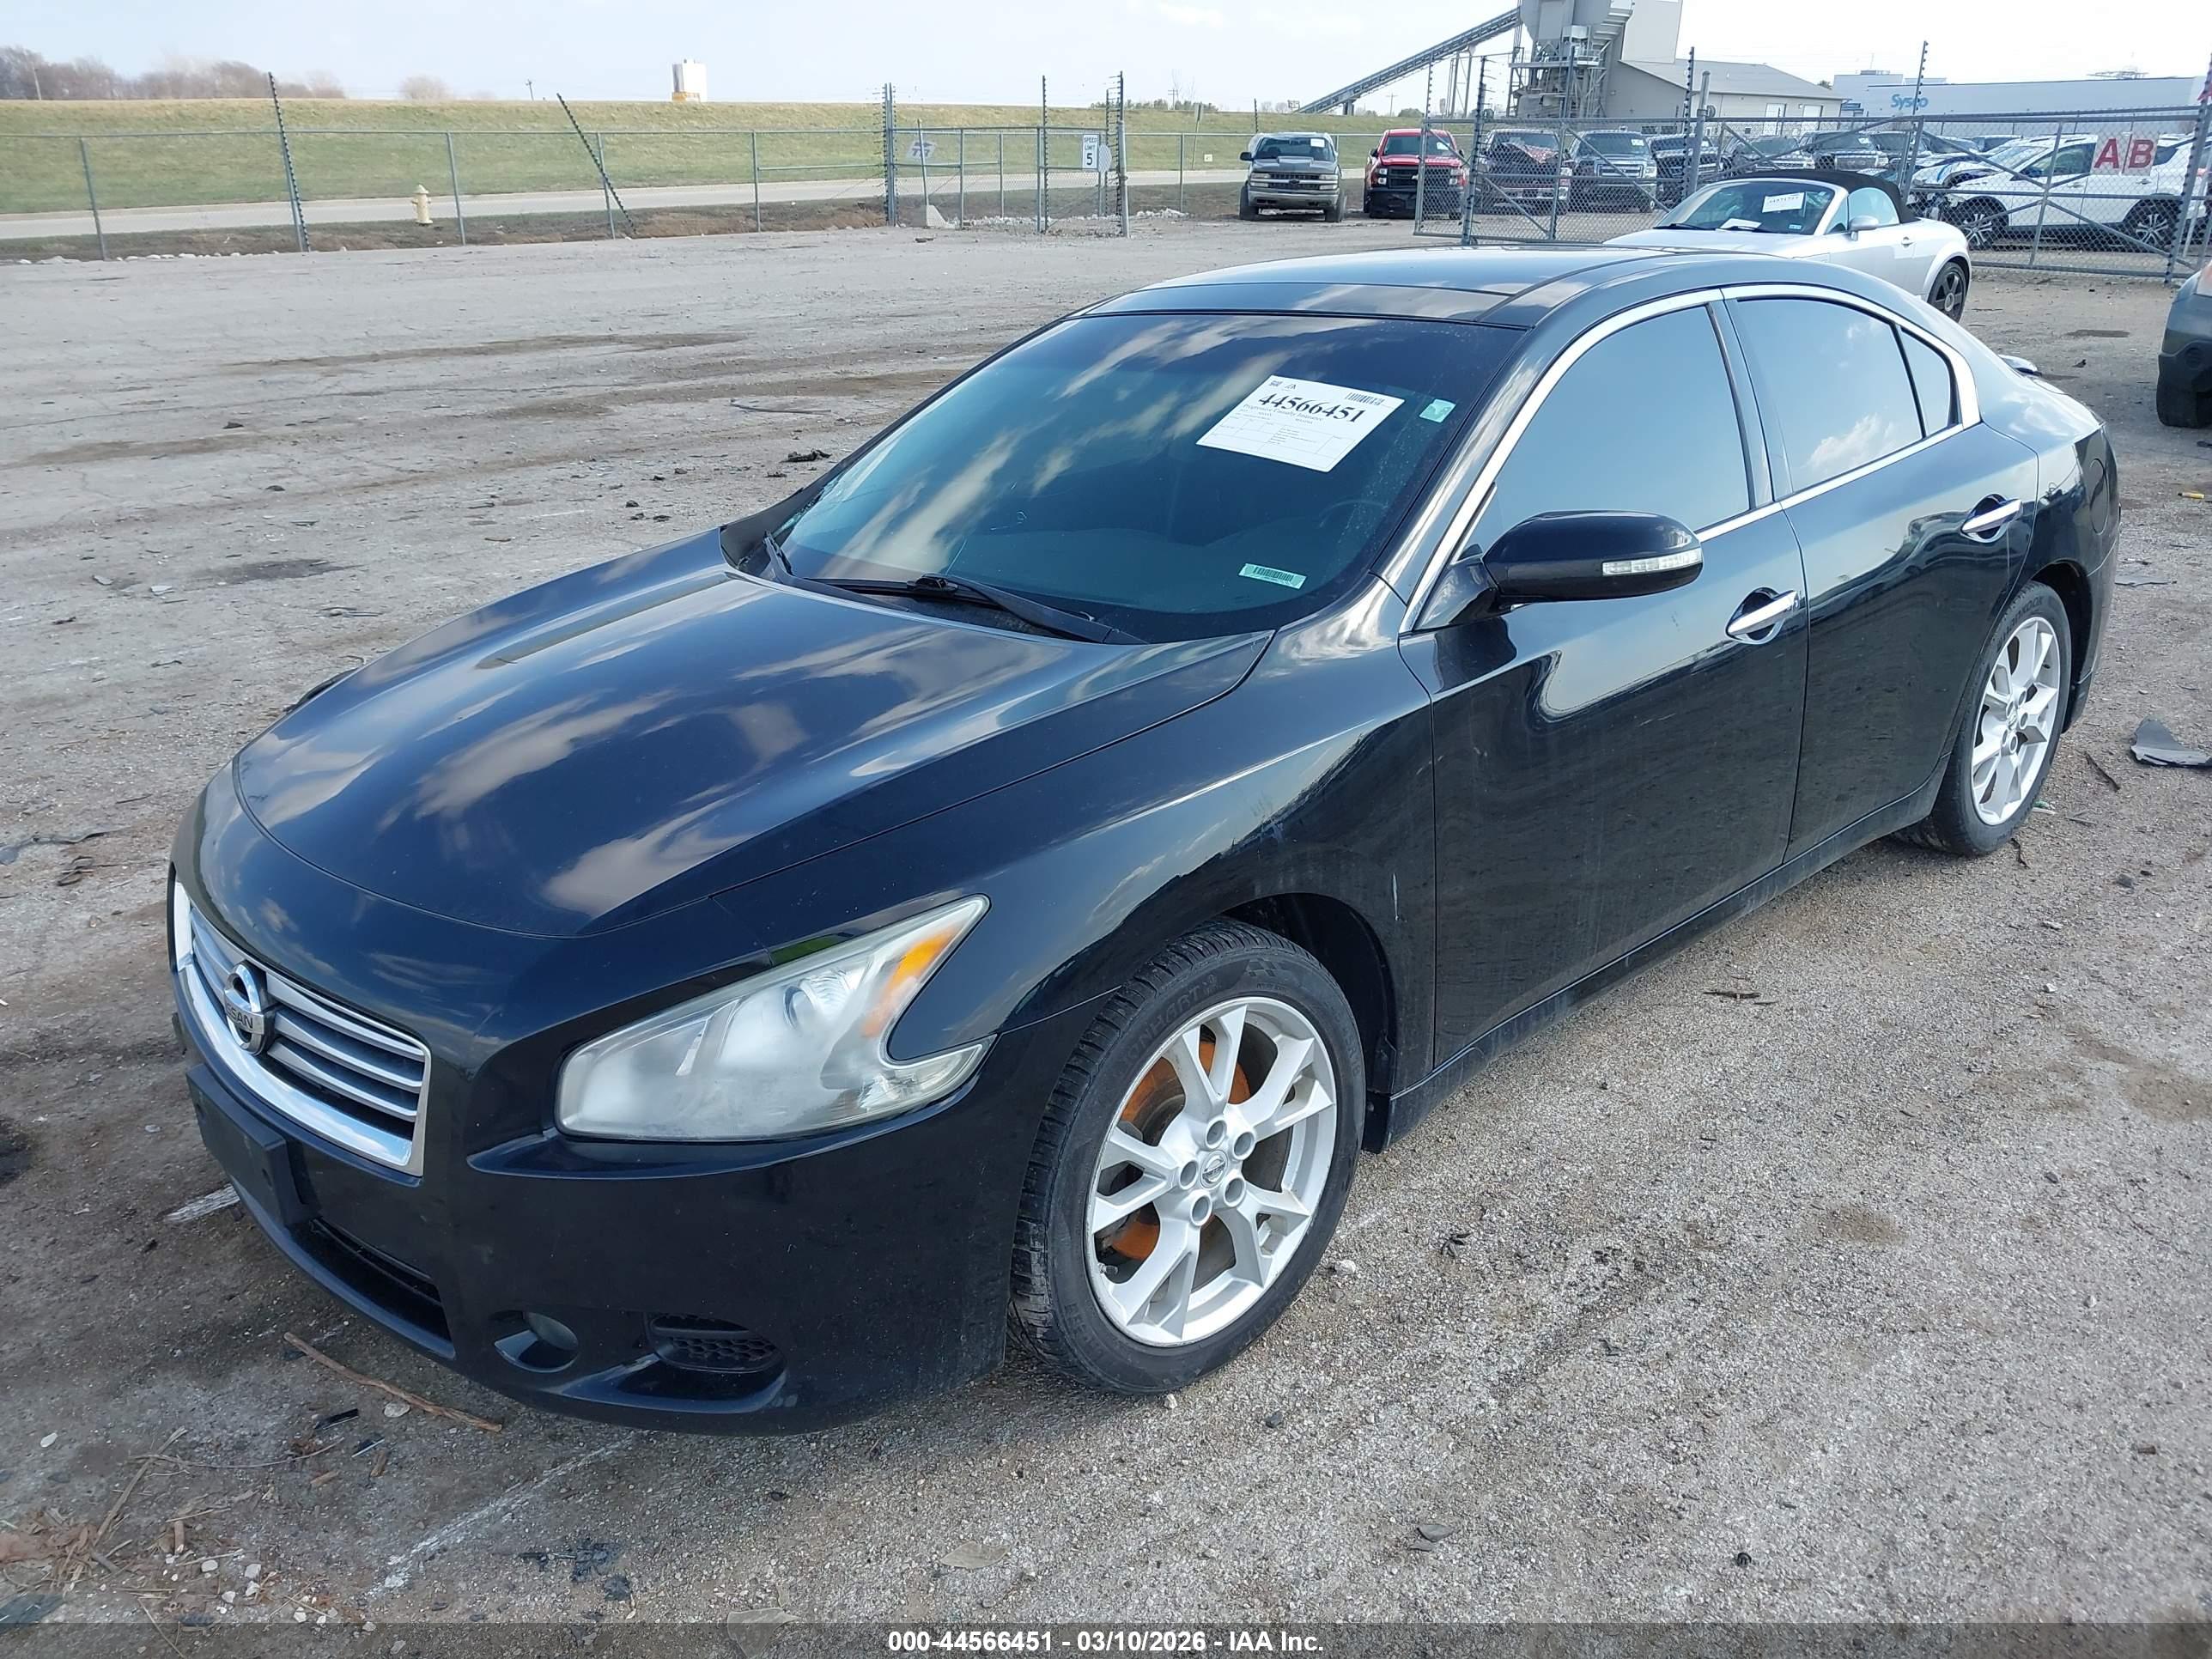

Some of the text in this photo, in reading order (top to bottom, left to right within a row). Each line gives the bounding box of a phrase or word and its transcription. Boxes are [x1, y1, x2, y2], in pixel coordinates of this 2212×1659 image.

[1086, 152, 1093, 166] 5
[2094, 138, 2154, 168] A B
[1258, 392, 1366, 423] 44566451
